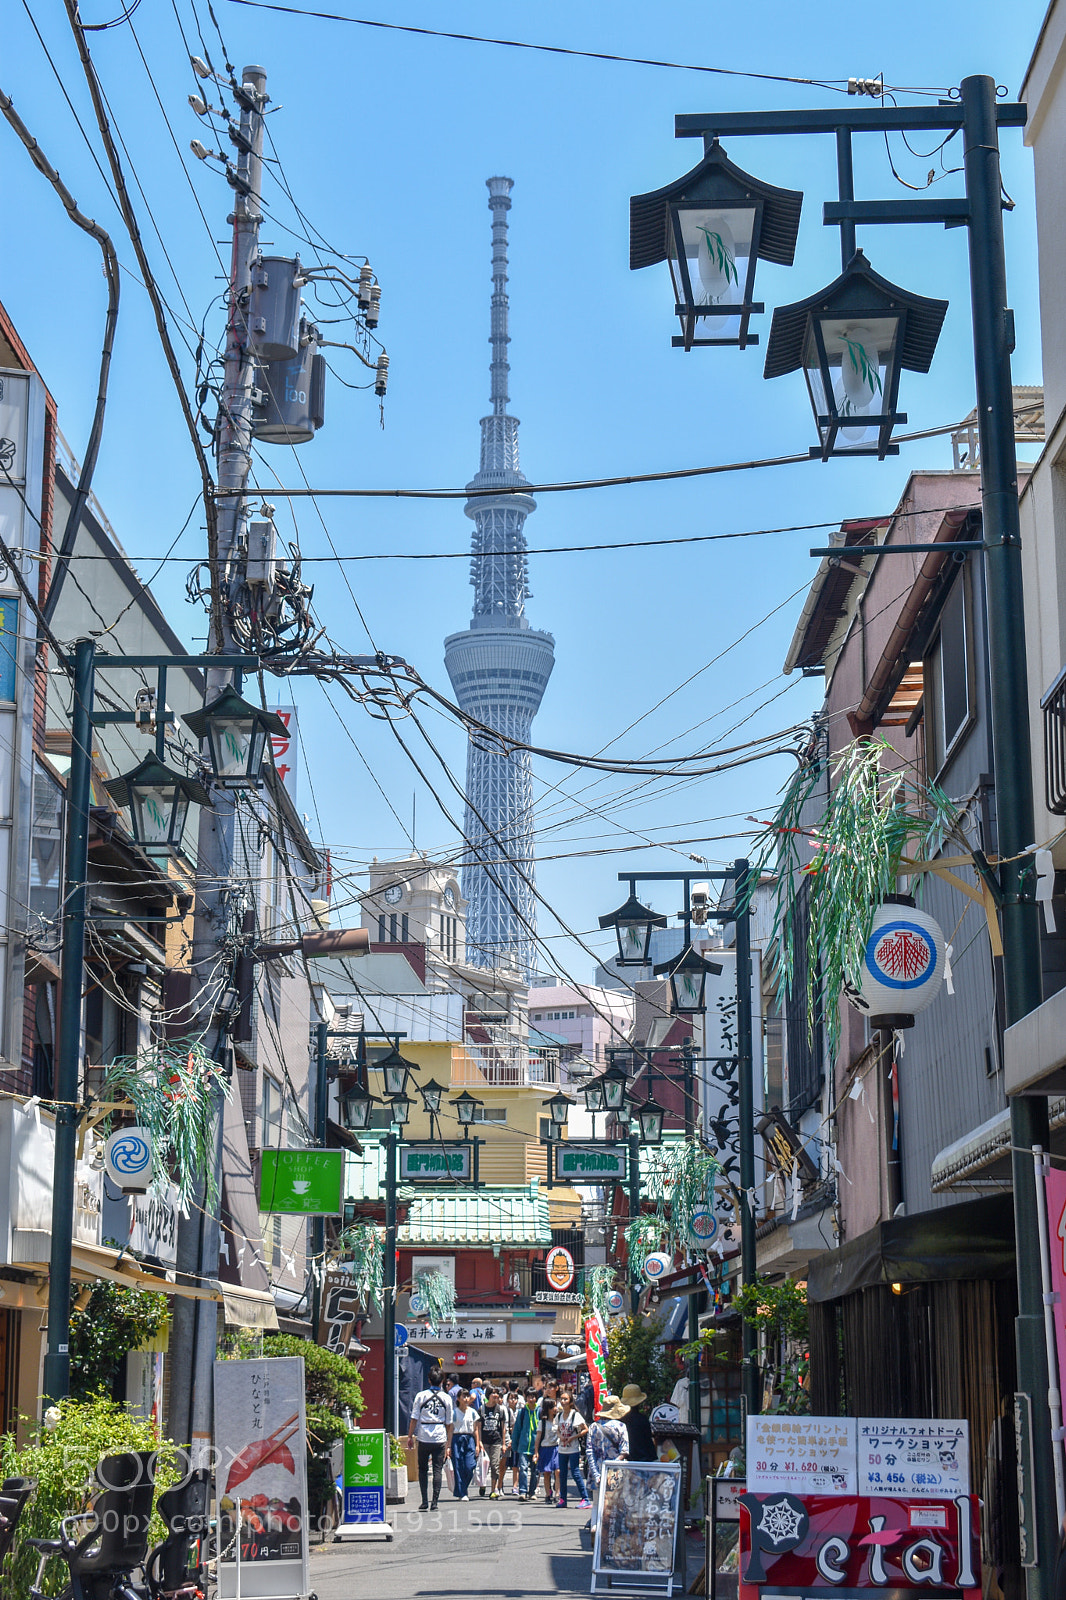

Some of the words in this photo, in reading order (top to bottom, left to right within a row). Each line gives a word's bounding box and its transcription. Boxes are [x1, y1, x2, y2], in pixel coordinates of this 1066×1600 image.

[272, 1153, 332, 1169] COFFEE
[407, 1327, 468, 1340] 酒井古堂
[250, 1374, 263, 1429] ひなと丸
[862, 1426, 964, 1436] オリジナルフォトドーム
[347, 1435, 380, 1445] COFFEE
[868, 1437, 959, 1450] ワークショップ
[765, 1447, 840, 1458] ワークショップ
[736, 1491, 979, 1588] Petal
